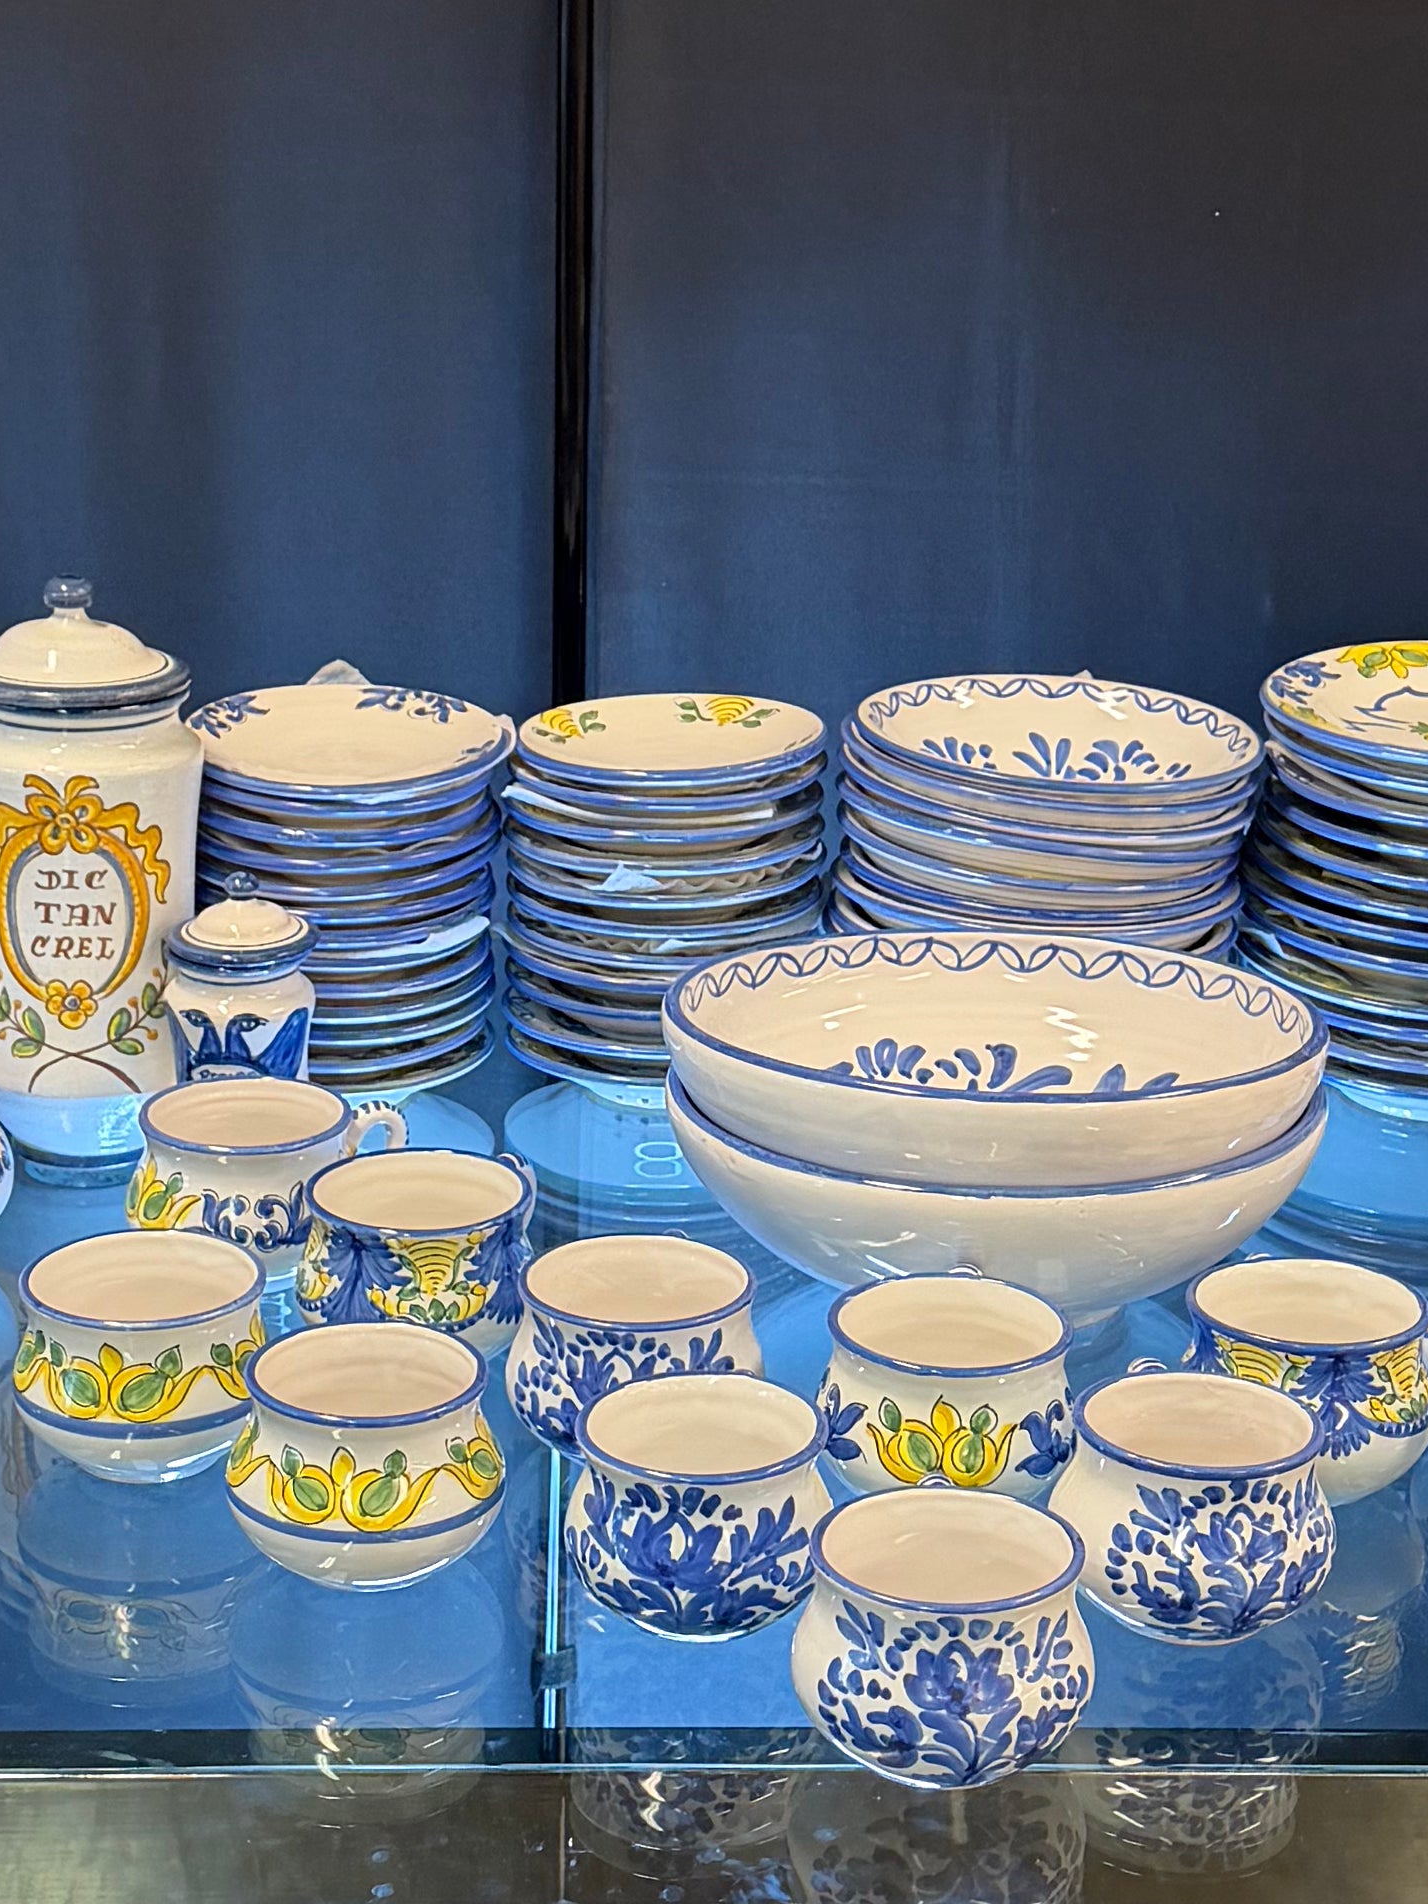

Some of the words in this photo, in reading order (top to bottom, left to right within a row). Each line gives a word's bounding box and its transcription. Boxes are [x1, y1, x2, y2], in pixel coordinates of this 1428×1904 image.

[34, 868, 109, 891] DIC
[33, 900, 117, 927] TAN
[30, 935, 115, 960] CREL
